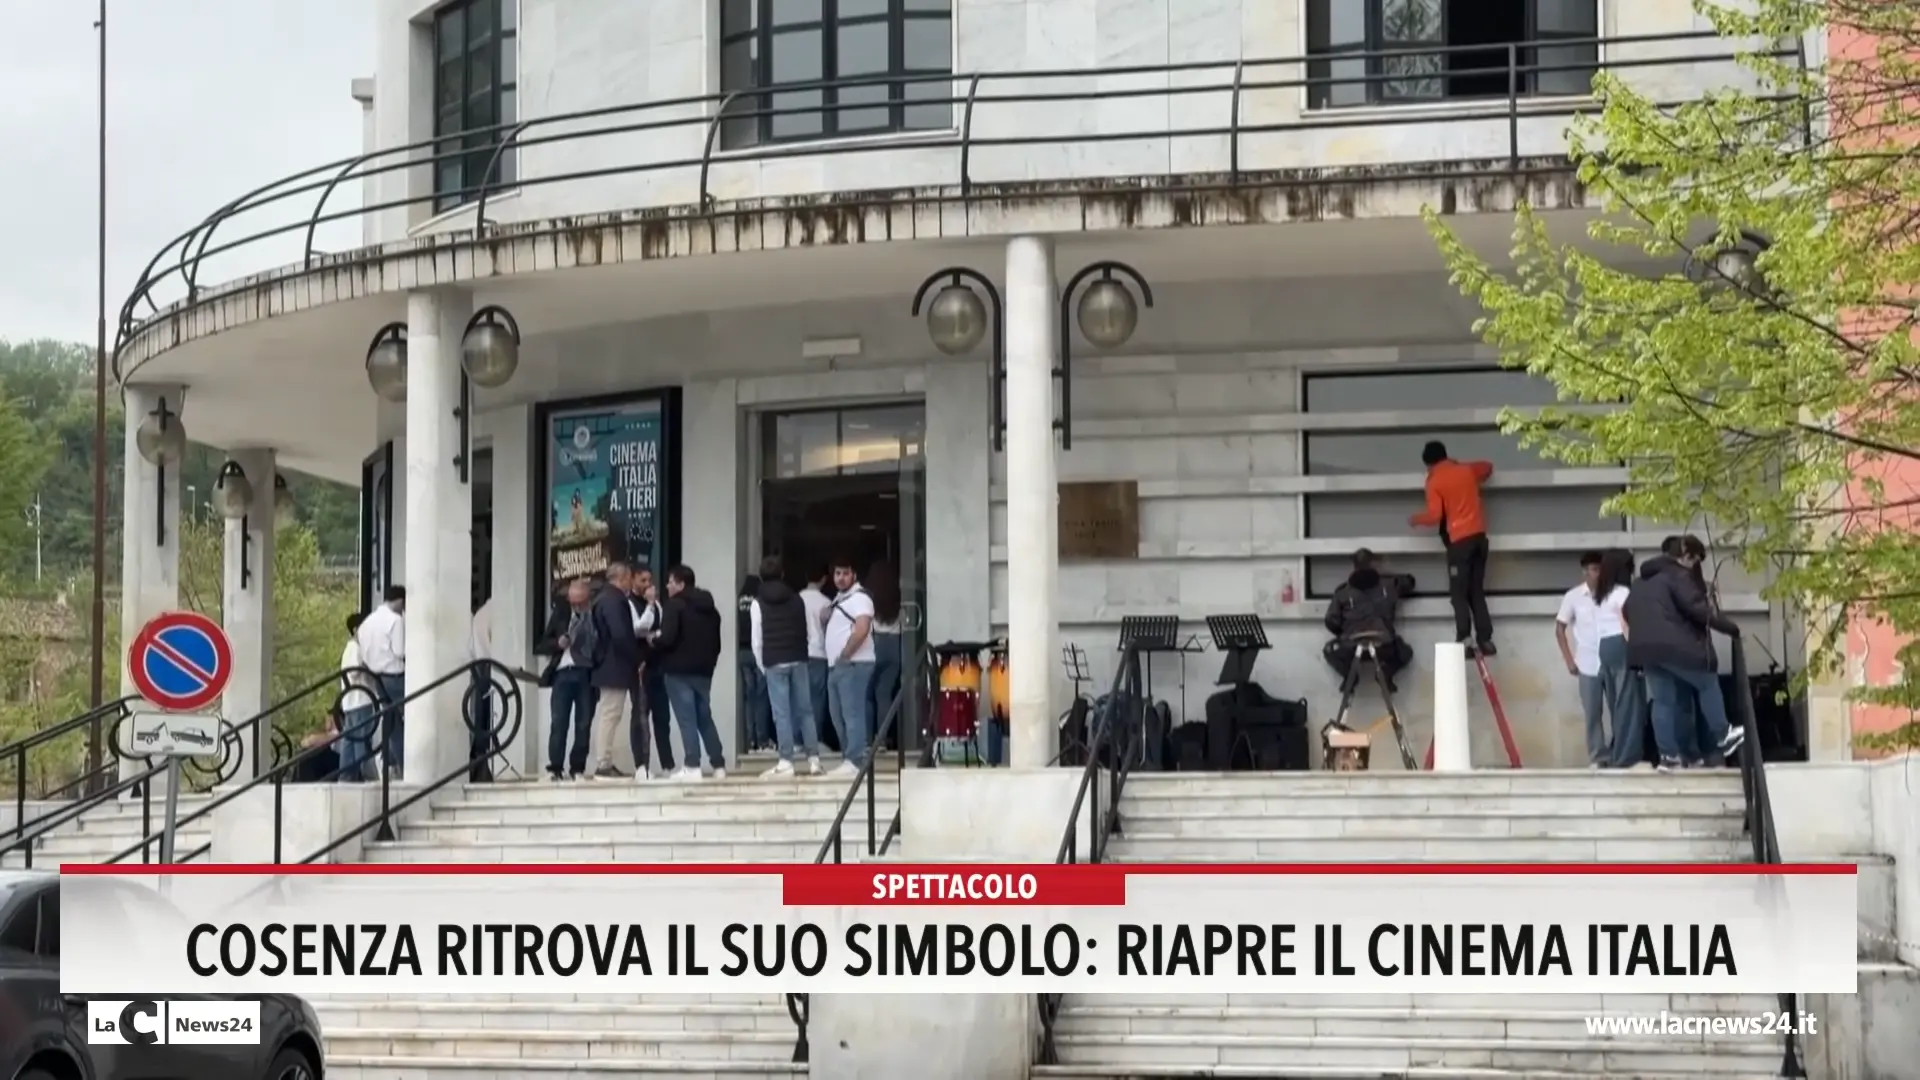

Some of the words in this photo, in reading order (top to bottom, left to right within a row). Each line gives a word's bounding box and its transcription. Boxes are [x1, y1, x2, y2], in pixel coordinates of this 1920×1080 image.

[610, 441, 657, 466] CINEMA
[619, 463, 657, 488] ITALIA
[609, 489, 622, 512] A.
[626, 486, 656, 510] TIERI
